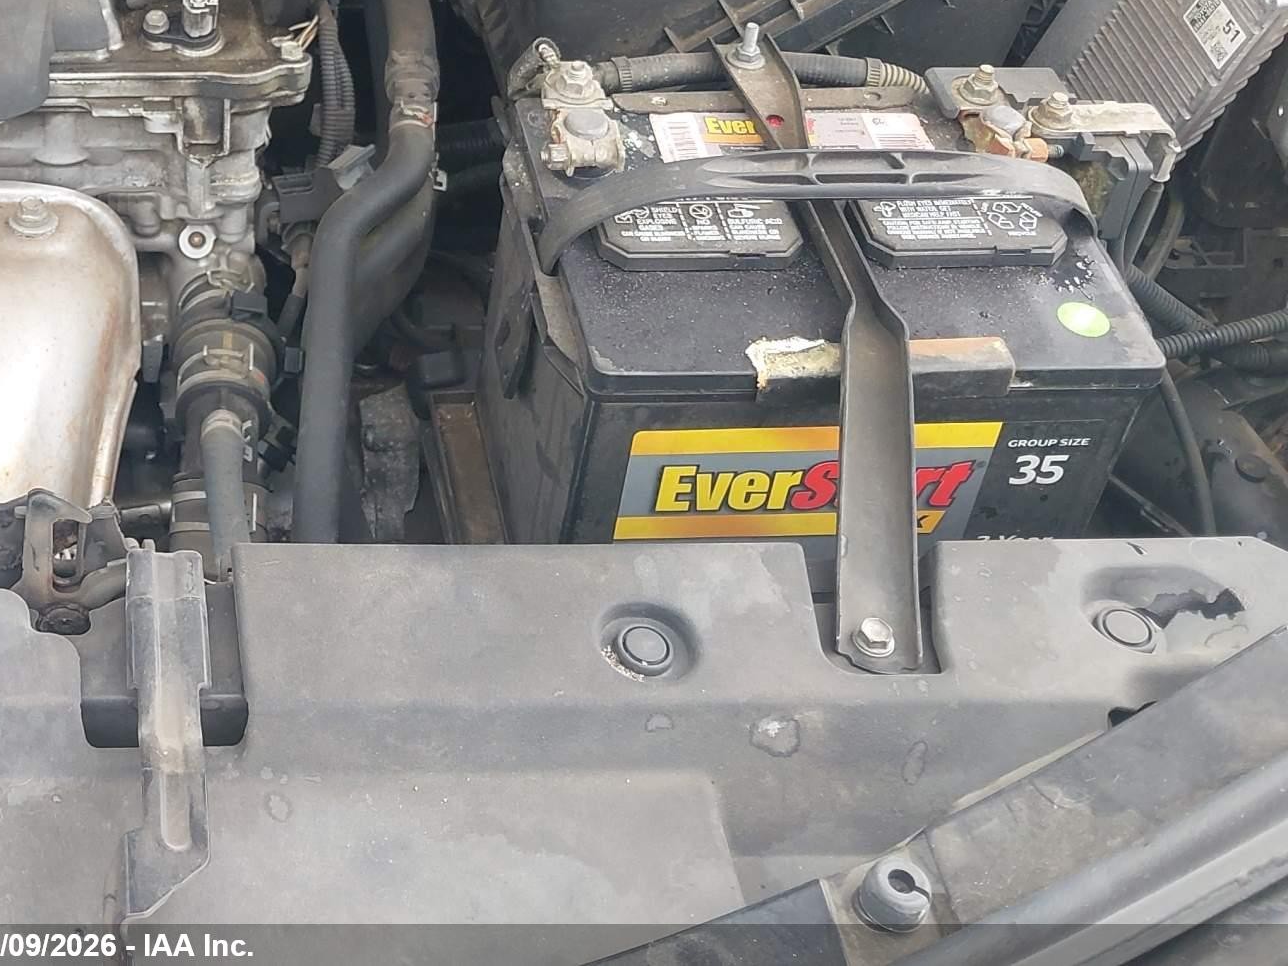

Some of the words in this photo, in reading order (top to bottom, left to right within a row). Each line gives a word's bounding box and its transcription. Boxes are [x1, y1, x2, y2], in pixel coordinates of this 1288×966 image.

[1222, 18, 1241, 43] 51
[651, 206, 678, 214] SHIELD
[1008, 438, 1057, 448] GROUP
[1058, 437, 1091, 447] SIZE
[1008, 454, 1070, 485] 35
[654, 460, 976, 513] EverSrt
